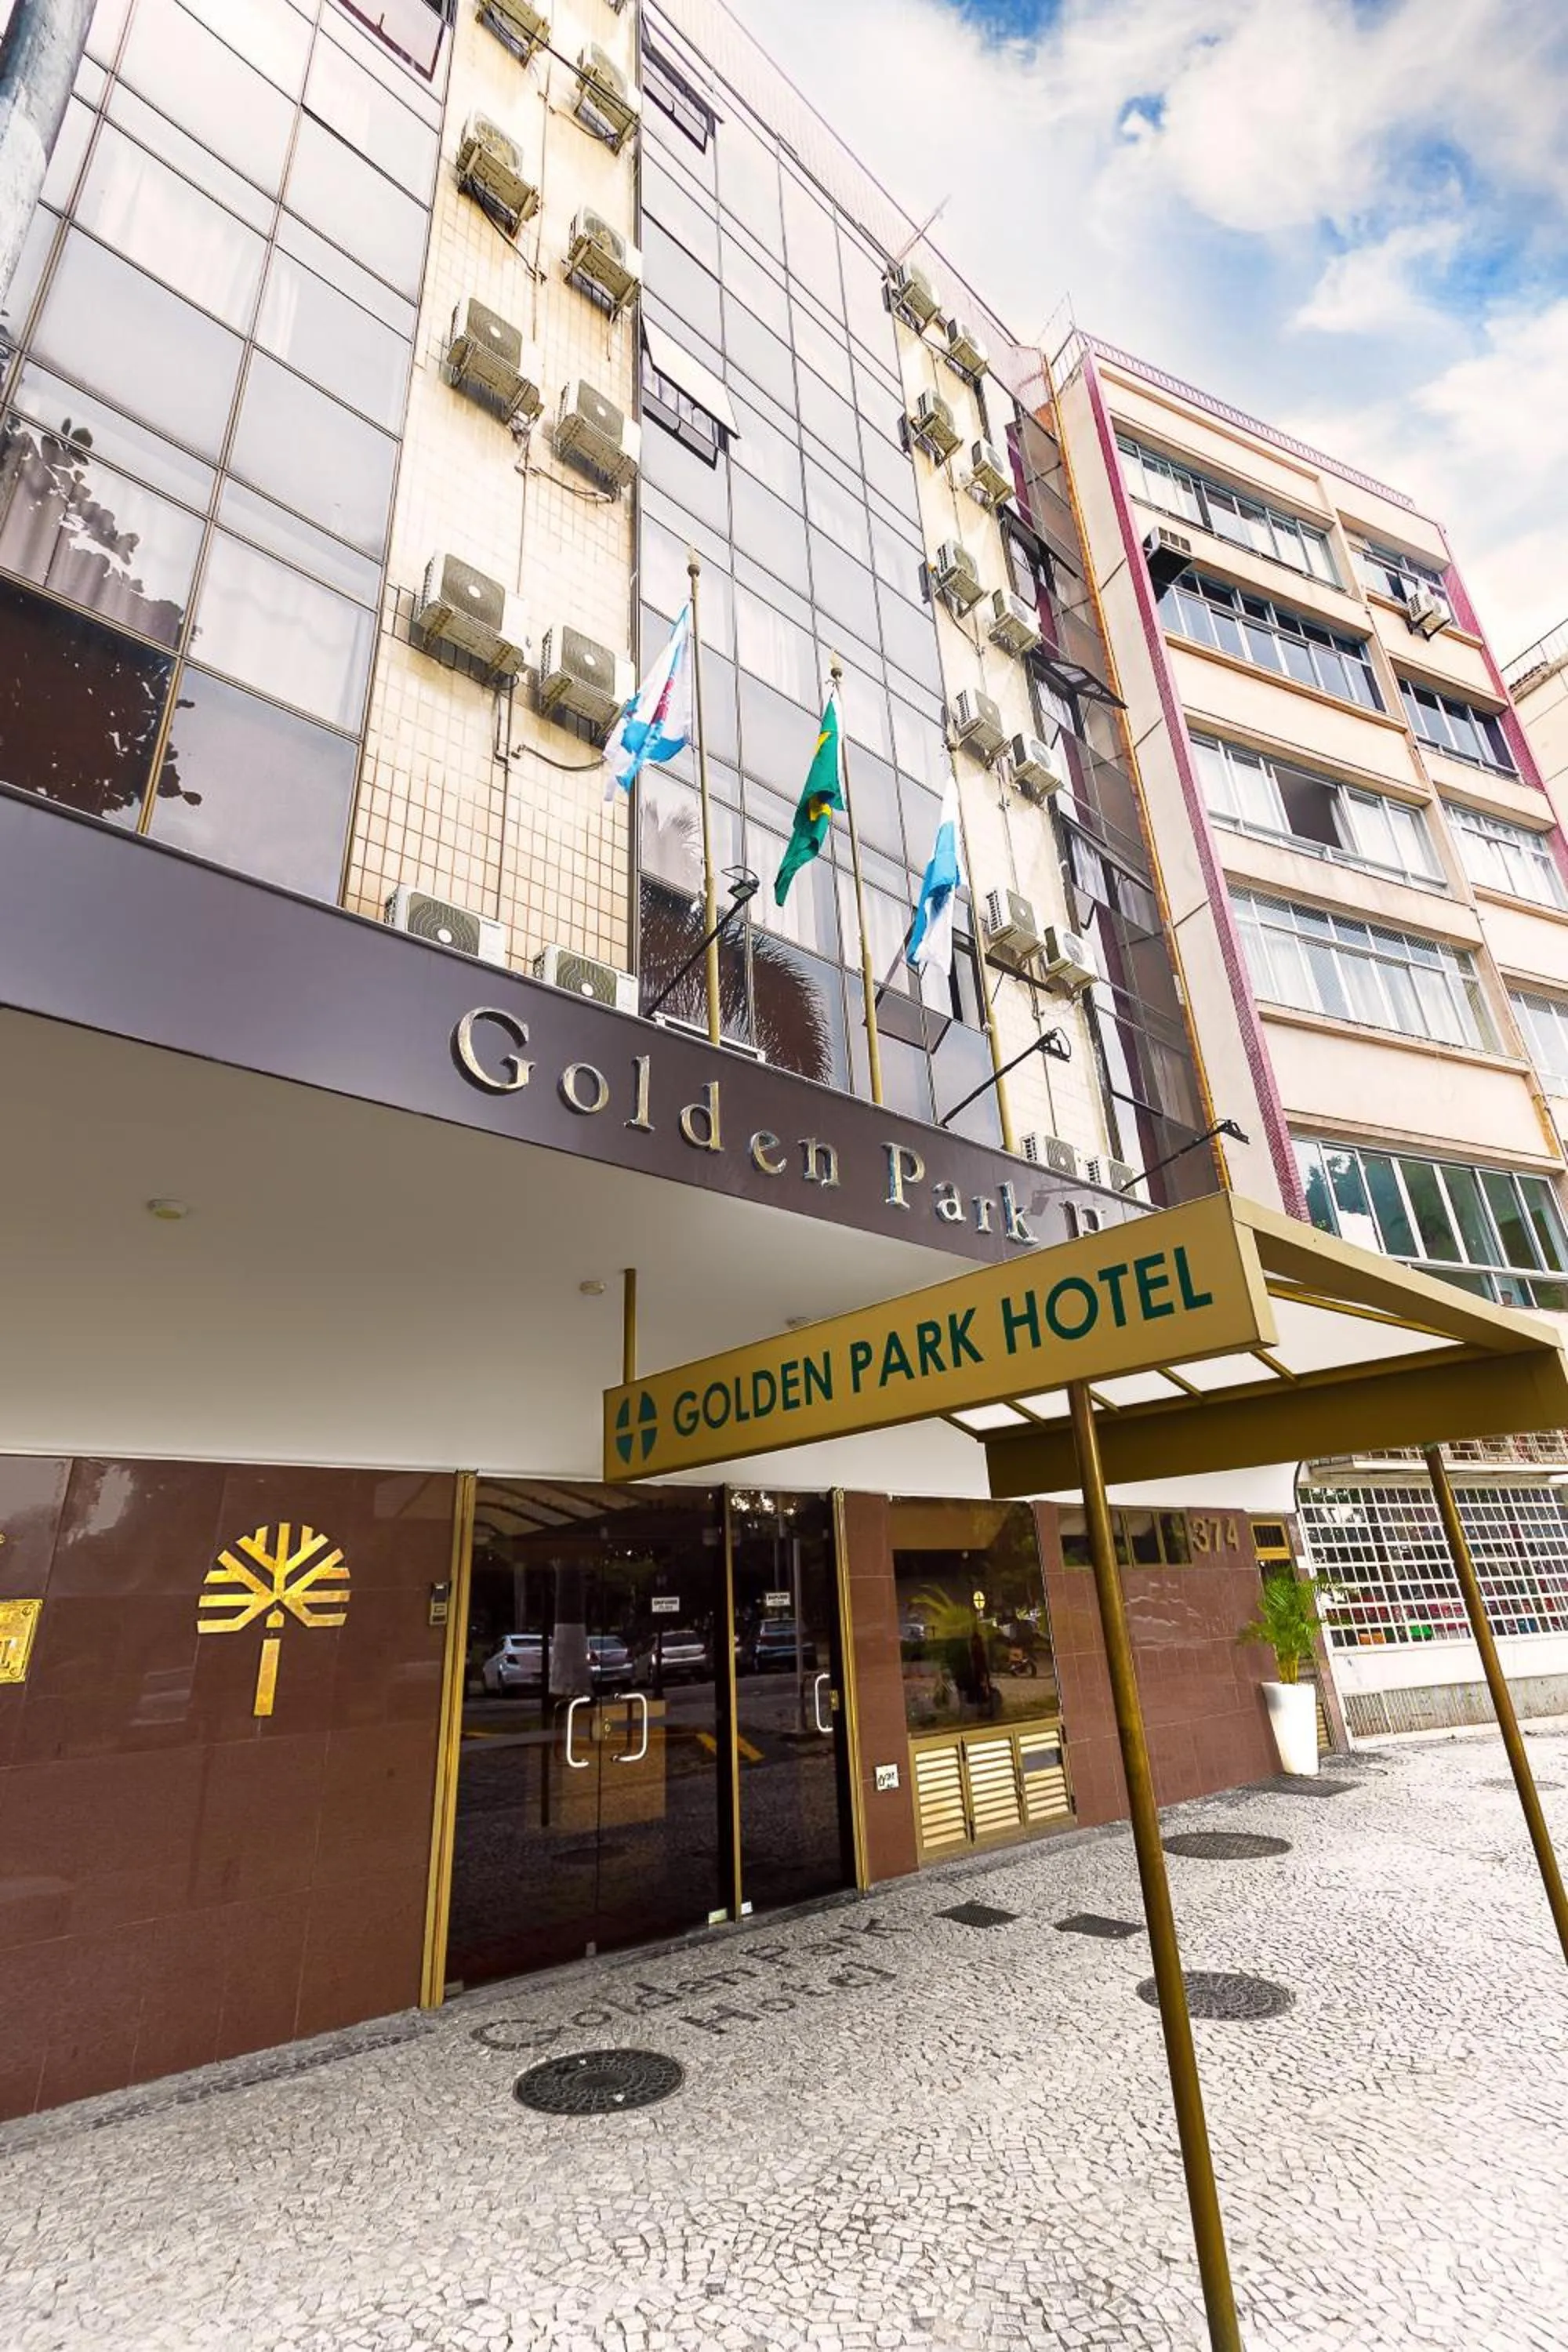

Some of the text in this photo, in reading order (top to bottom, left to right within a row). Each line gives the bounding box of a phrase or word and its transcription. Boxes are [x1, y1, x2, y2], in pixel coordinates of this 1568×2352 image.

[451, 1005, 1039, 1245] Golden Park
[673, 1246, 1213, 1437] GOLDEN PARK HOTEL
[1189, 1516, 1240, 1553] 374
[470, 1918, 913, 2052] Golden Park
[679, 1960, 898, 2036] Hotel
